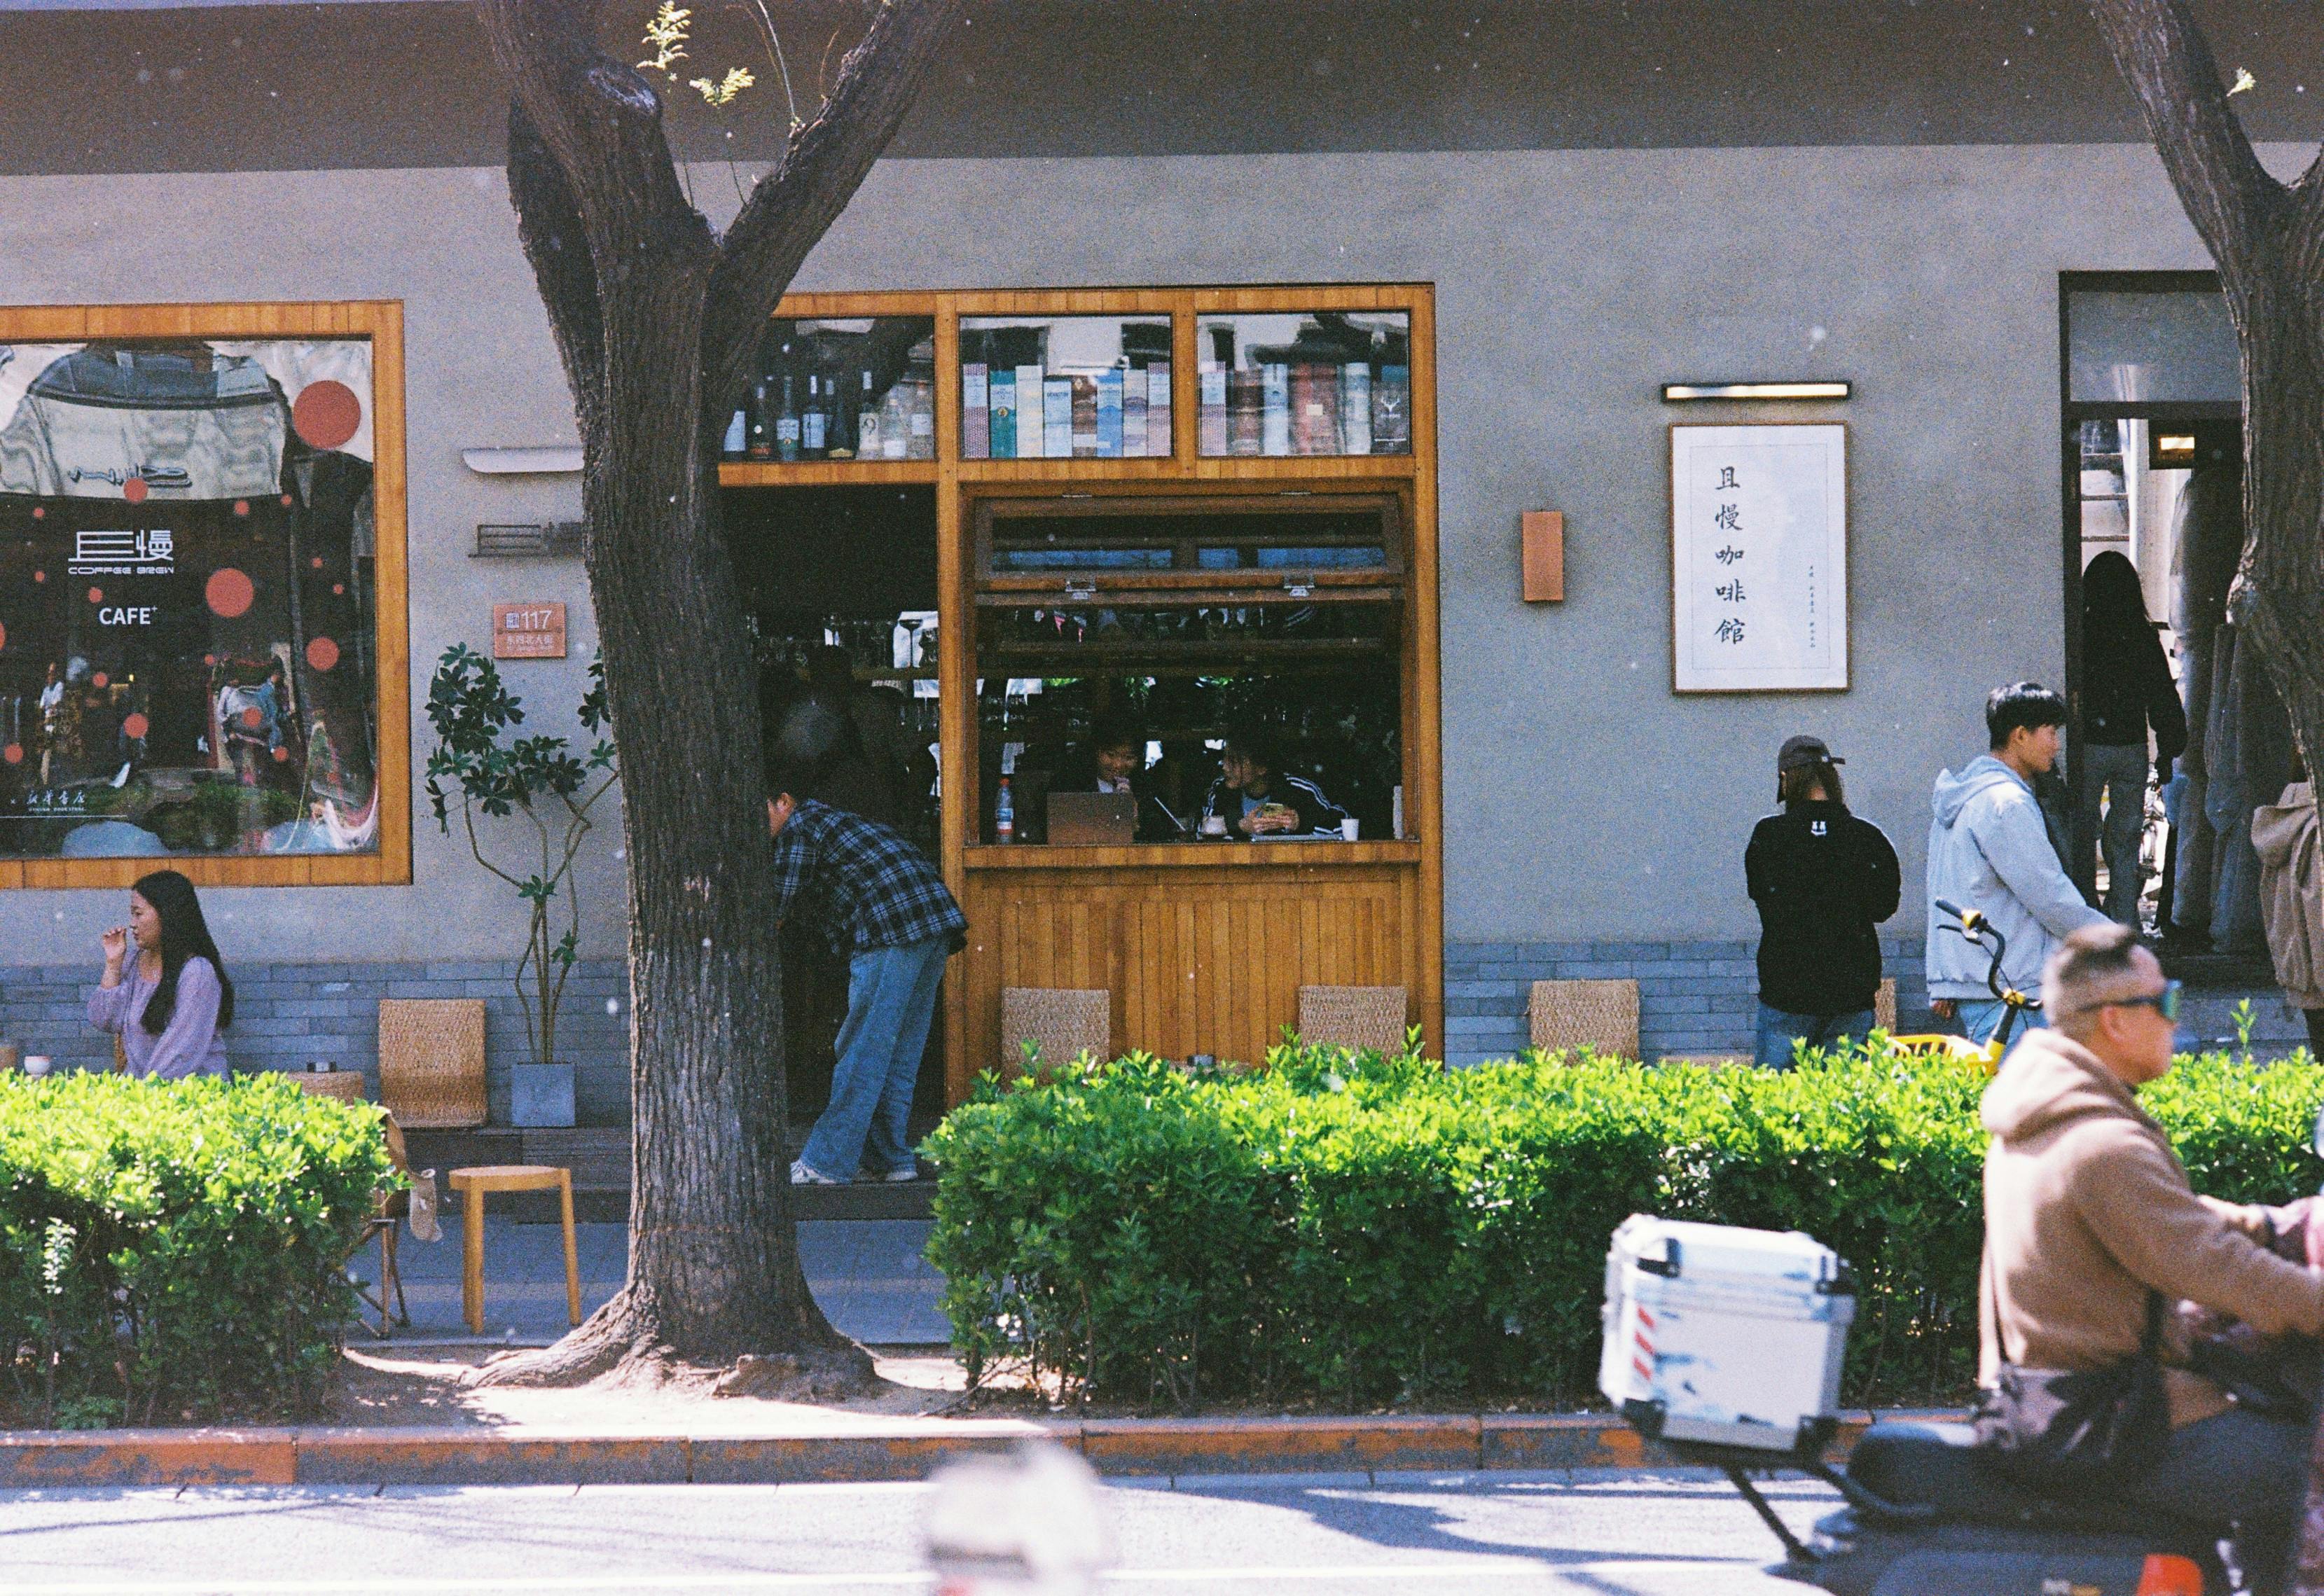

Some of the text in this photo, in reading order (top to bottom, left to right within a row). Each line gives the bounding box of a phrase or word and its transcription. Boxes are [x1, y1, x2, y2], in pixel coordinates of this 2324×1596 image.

[1715, 465, 1747, 646] 且慢咖啡館
[68, 567, 132, 575] COFFEE
[520, 609, 553, 630] 117
